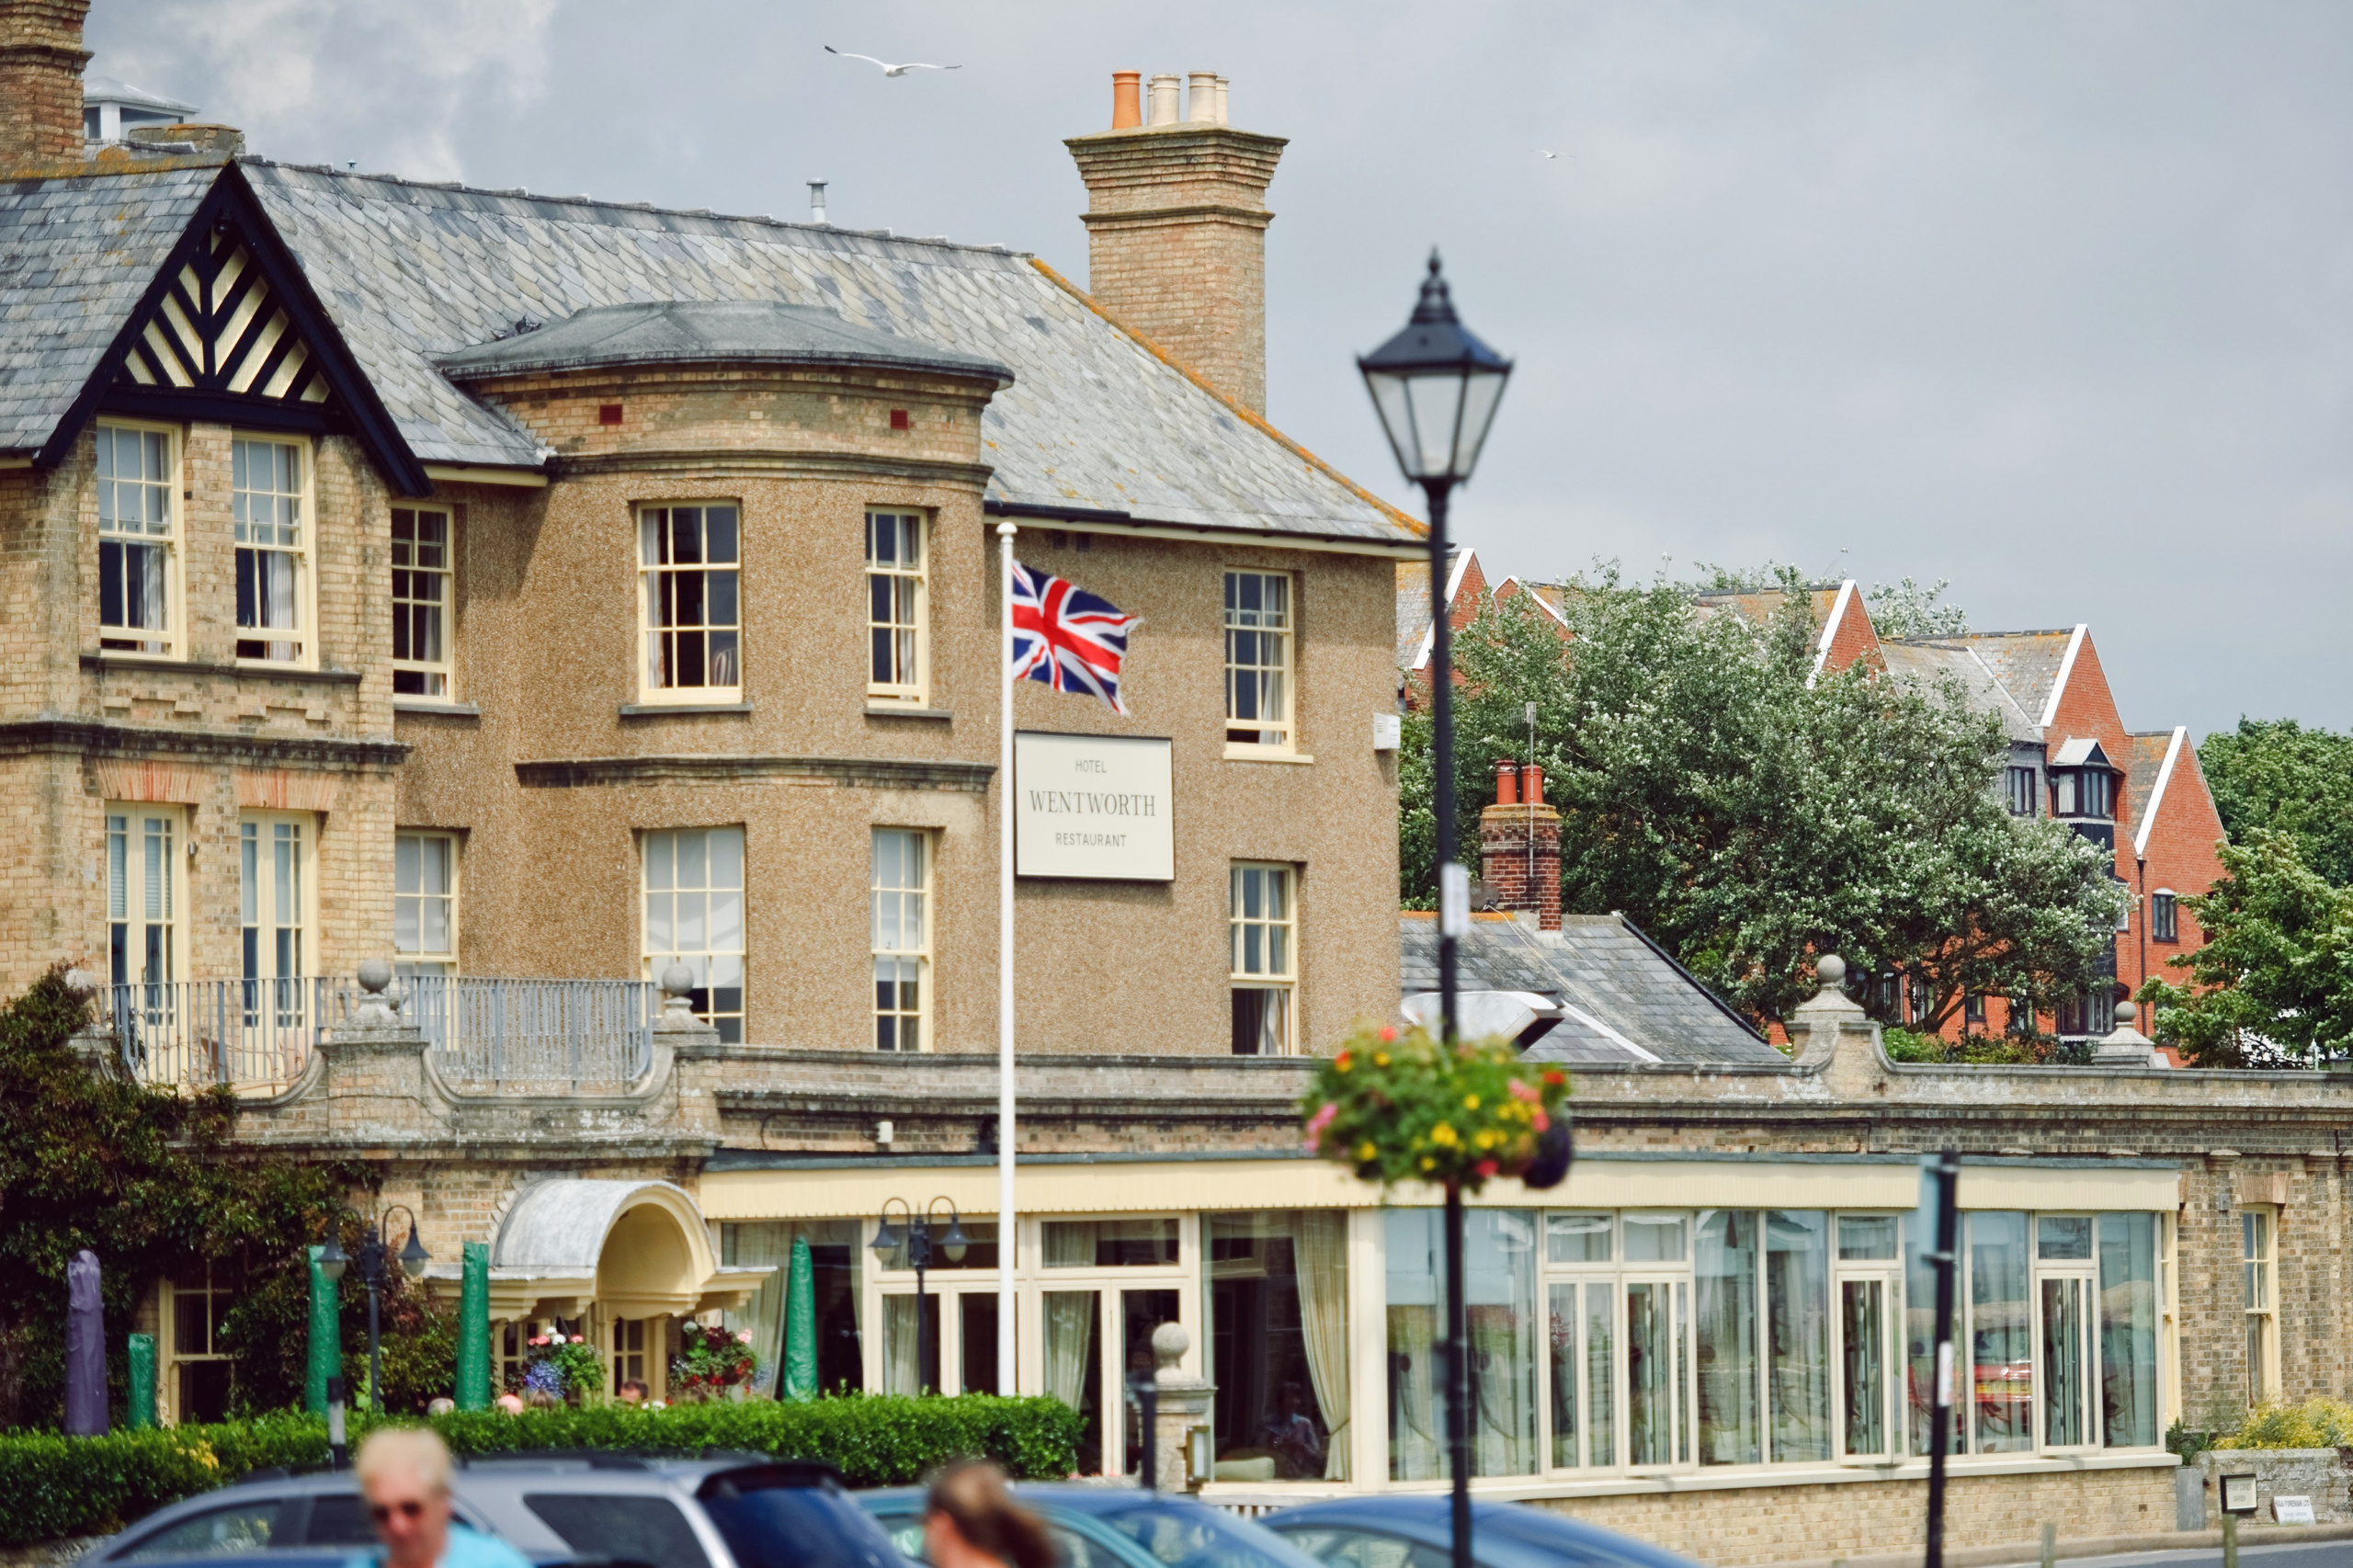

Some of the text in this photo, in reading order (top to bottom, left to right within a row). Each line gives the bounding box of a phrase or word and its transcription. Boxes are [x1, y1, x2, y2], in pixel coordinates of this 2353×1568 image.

[1075, 759, 1107, 774] HOTEL
[1029, 790, 1156, 817] WENTWORTH
[1055, 833, 1127, 847] RESTAURANT
